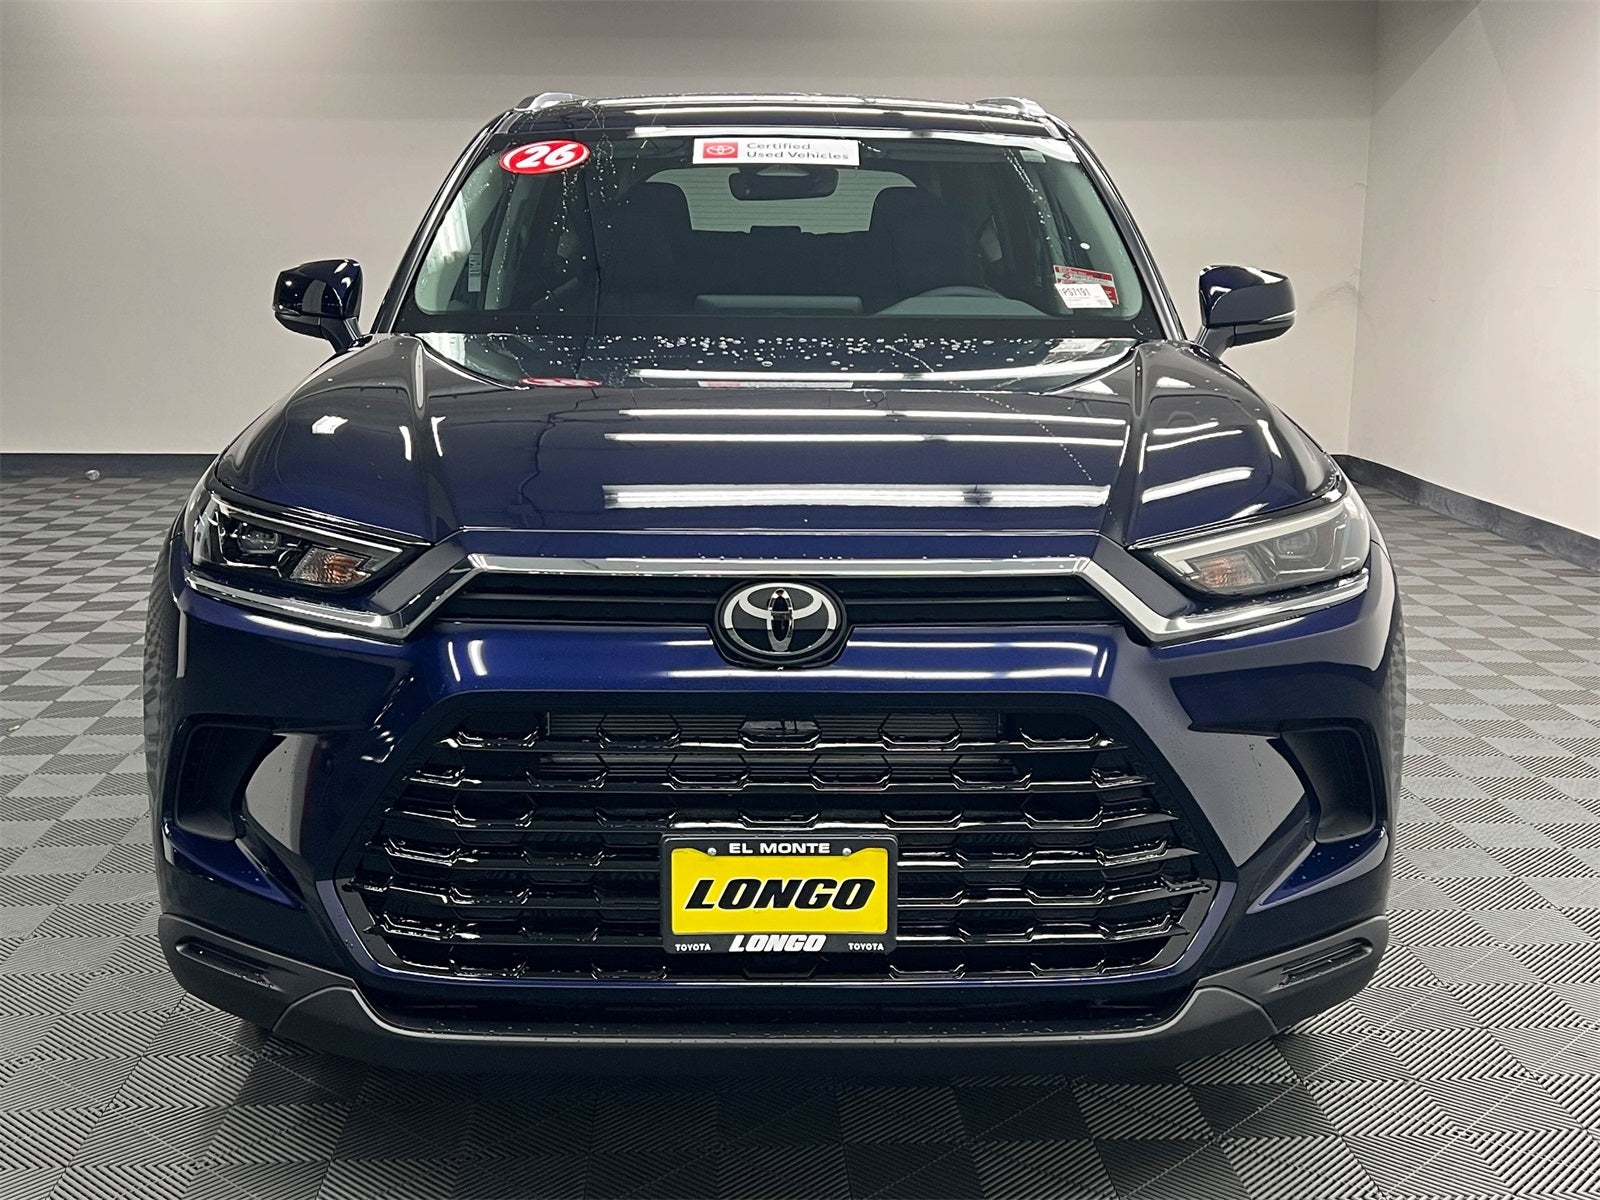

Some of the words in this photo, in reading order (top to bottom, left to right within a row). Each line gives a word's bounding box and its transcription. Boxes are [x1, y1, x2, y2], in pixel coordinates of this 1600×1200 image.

[746, 142, 811, 150] Certified
[515, 143, 579, 169] 26
[788, 151, 849, 160] Vehicles
[728, 842, 753, 854] EL
[759, 842, 831, 854] MONTE
[684, 878, 877, 910] LONGO
[674, 943, 711, 952] TOYOTA
[728, 934, 827, 952] LONGO
[848, 942, 884, 951] TOYOTA
